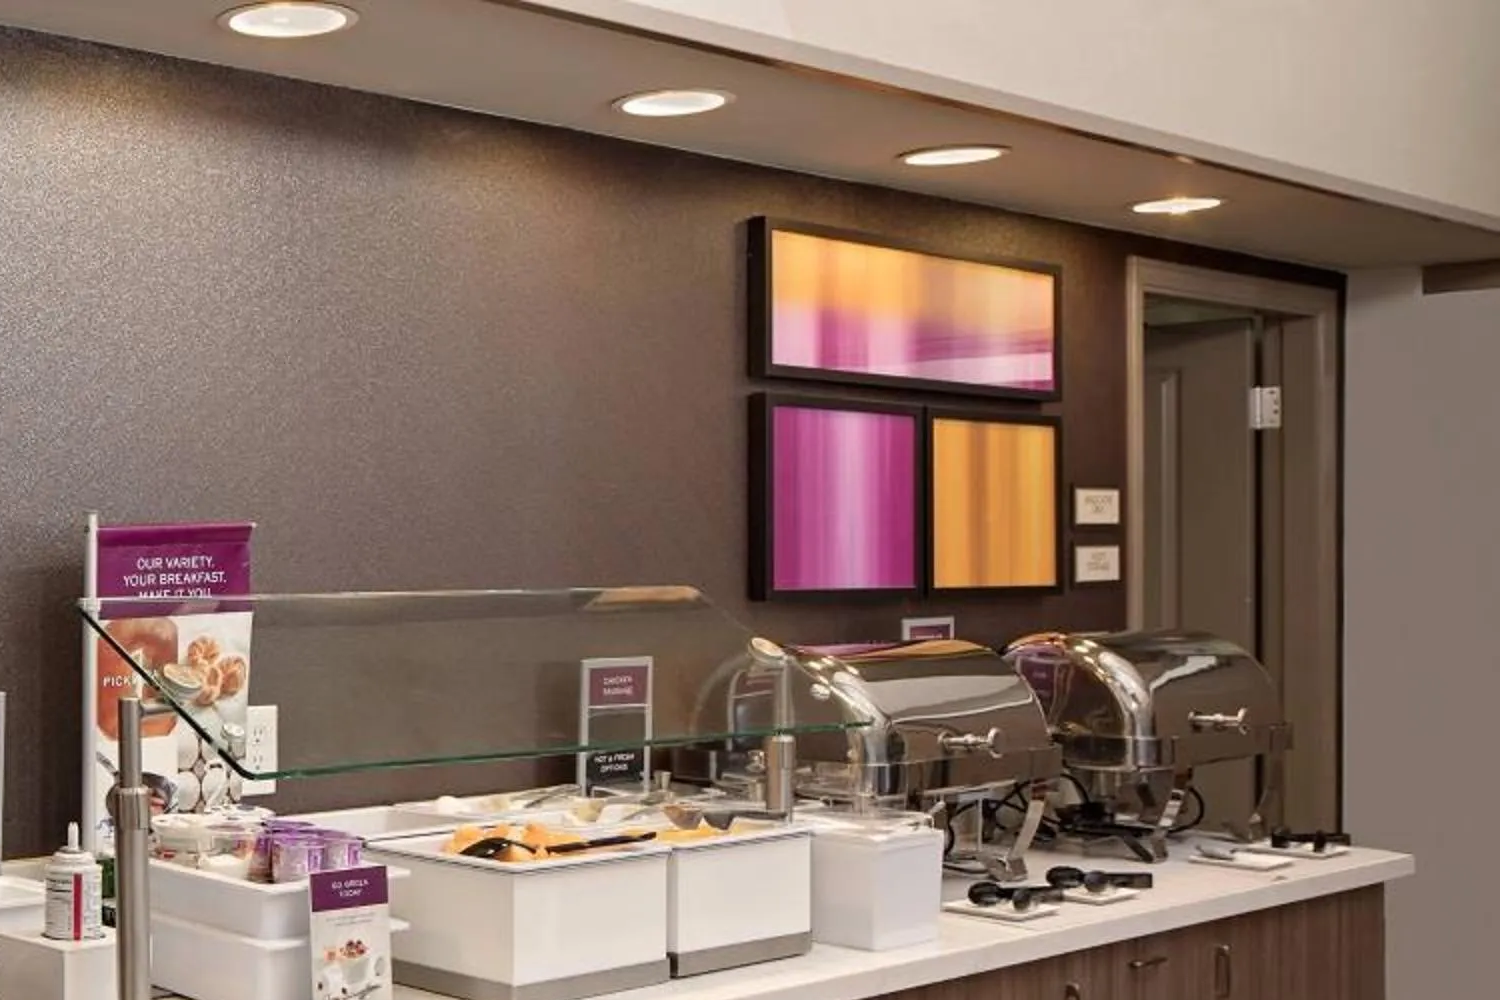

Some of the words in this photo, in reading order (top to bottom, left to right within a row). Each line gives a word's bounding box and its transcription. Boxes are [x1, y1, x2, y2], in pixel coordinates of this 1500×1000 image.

[137, 557, 163, 570] OUR
[165, 555, 215, 569] VARIETY.
[123, 573, 156, 587] YOUR
[159, 571, 227, 585] BREAKFAST.
